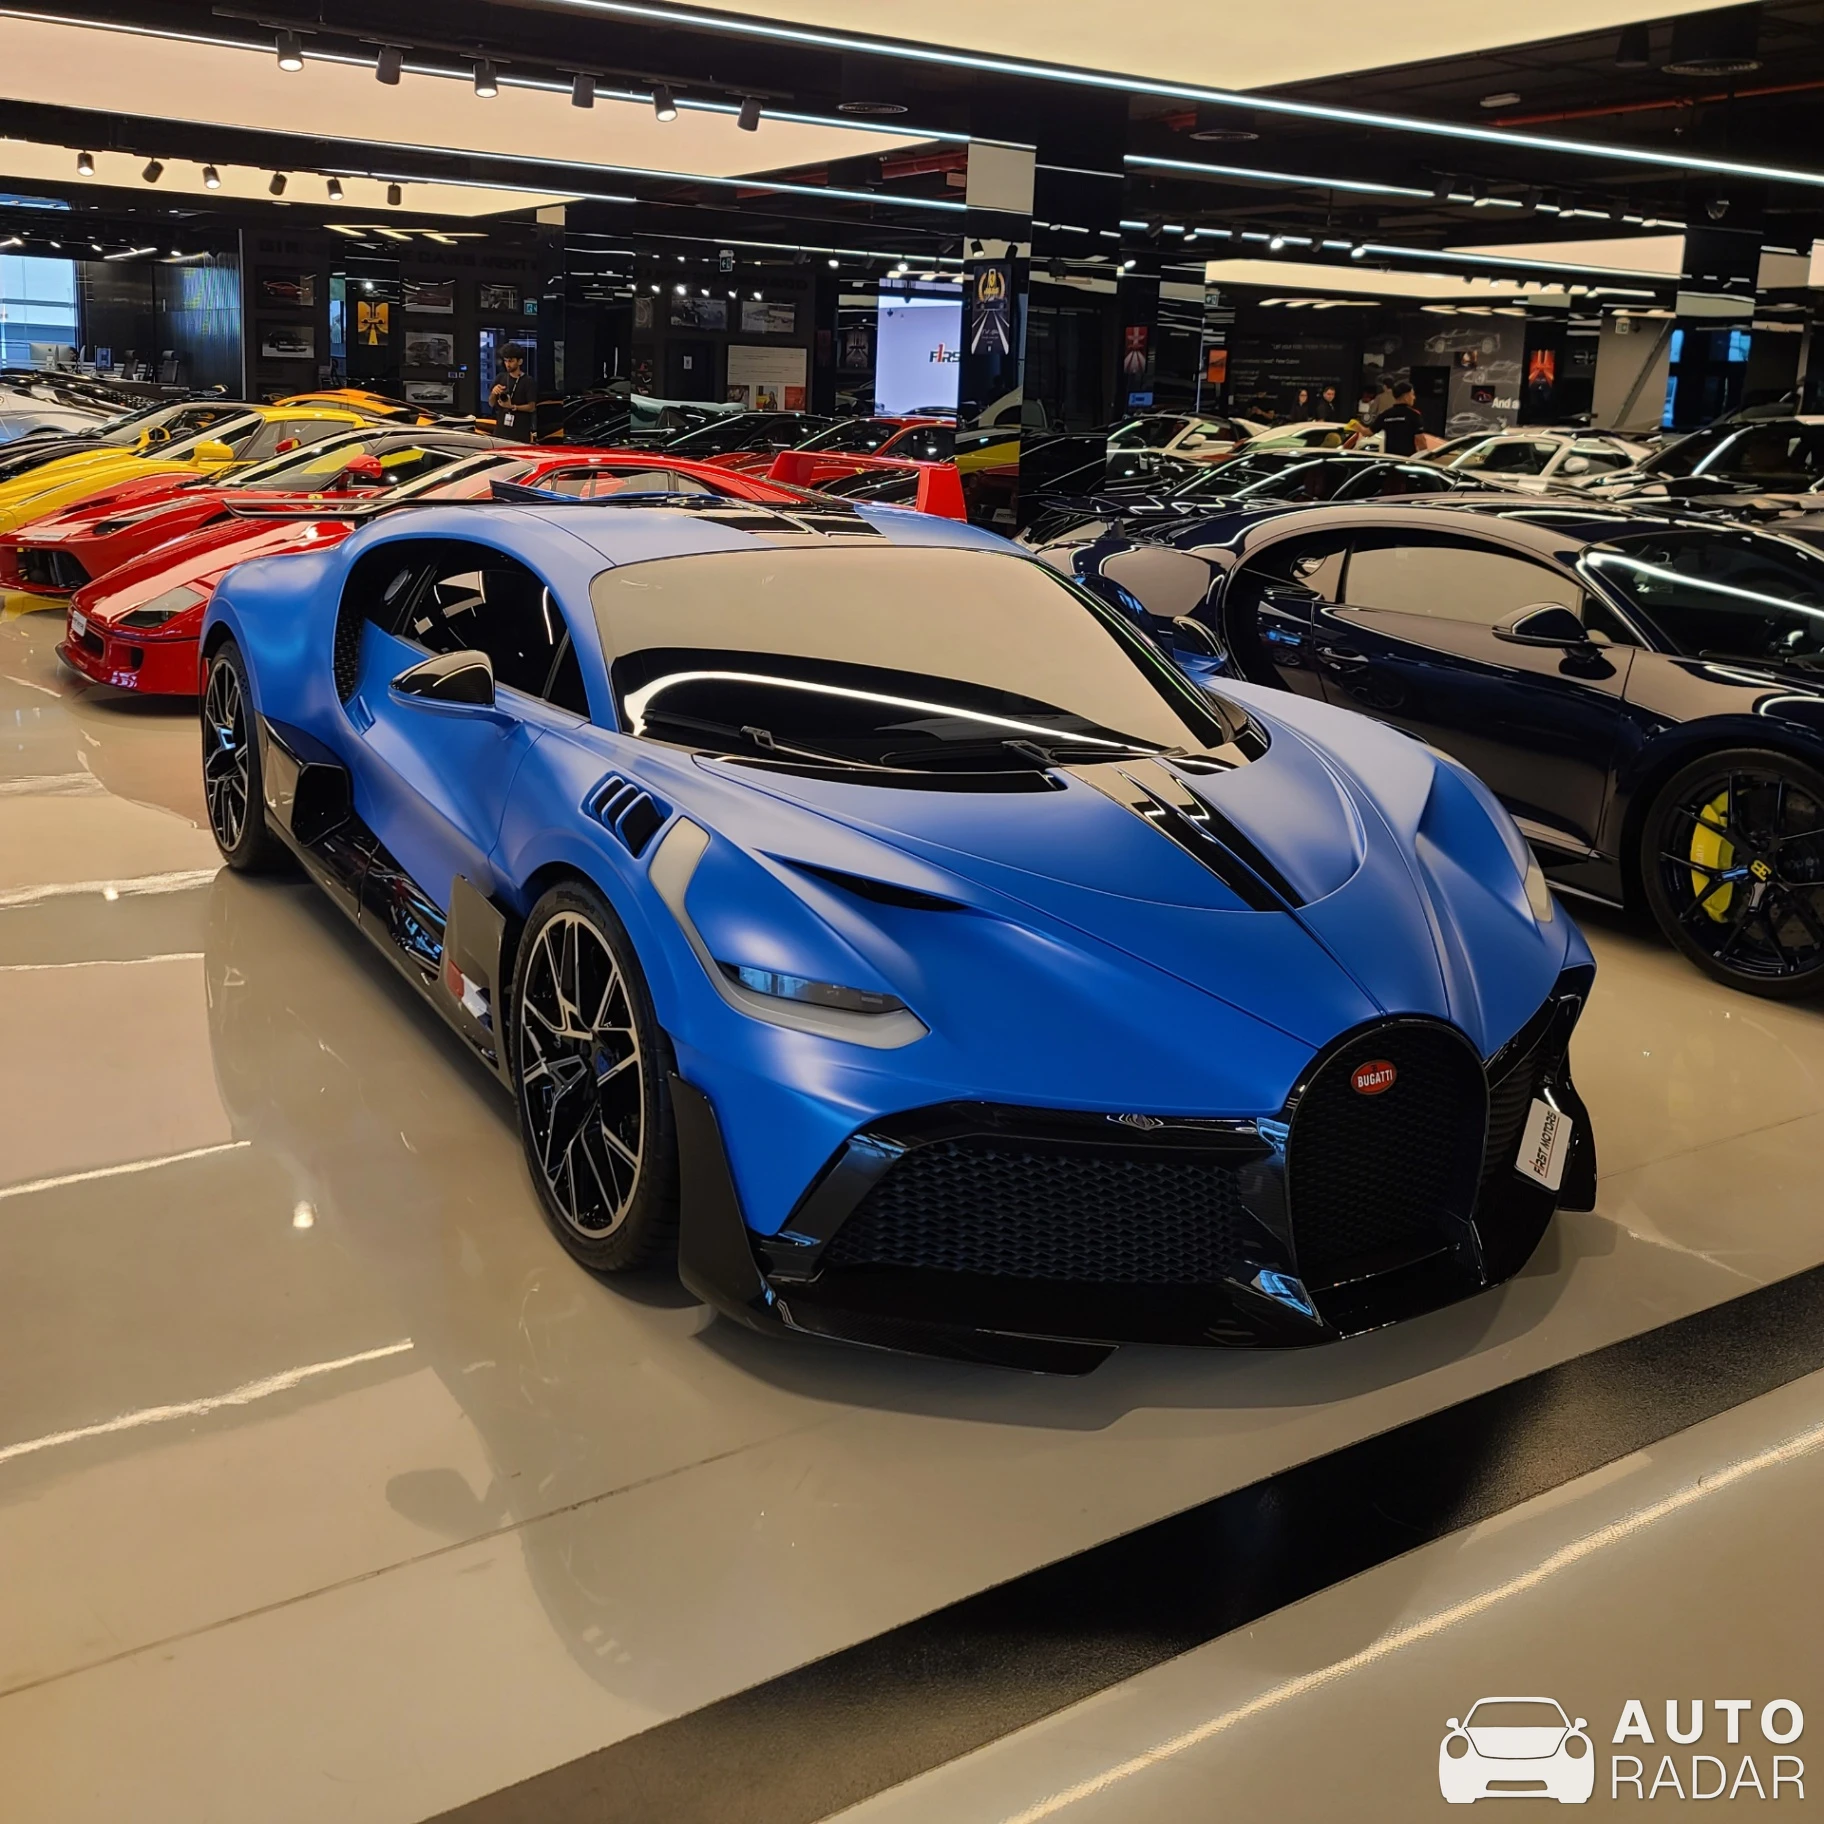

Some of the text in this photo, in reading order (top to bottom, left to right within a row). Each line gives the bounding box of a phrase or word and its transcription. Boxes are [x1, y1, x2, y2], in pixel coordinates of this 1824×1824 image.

[1491, 397, 1511, 409] And
[1357, 1069, 1393, 1088] BUGATTI
[1539, 1110, 1557, 1151] MOTORS
